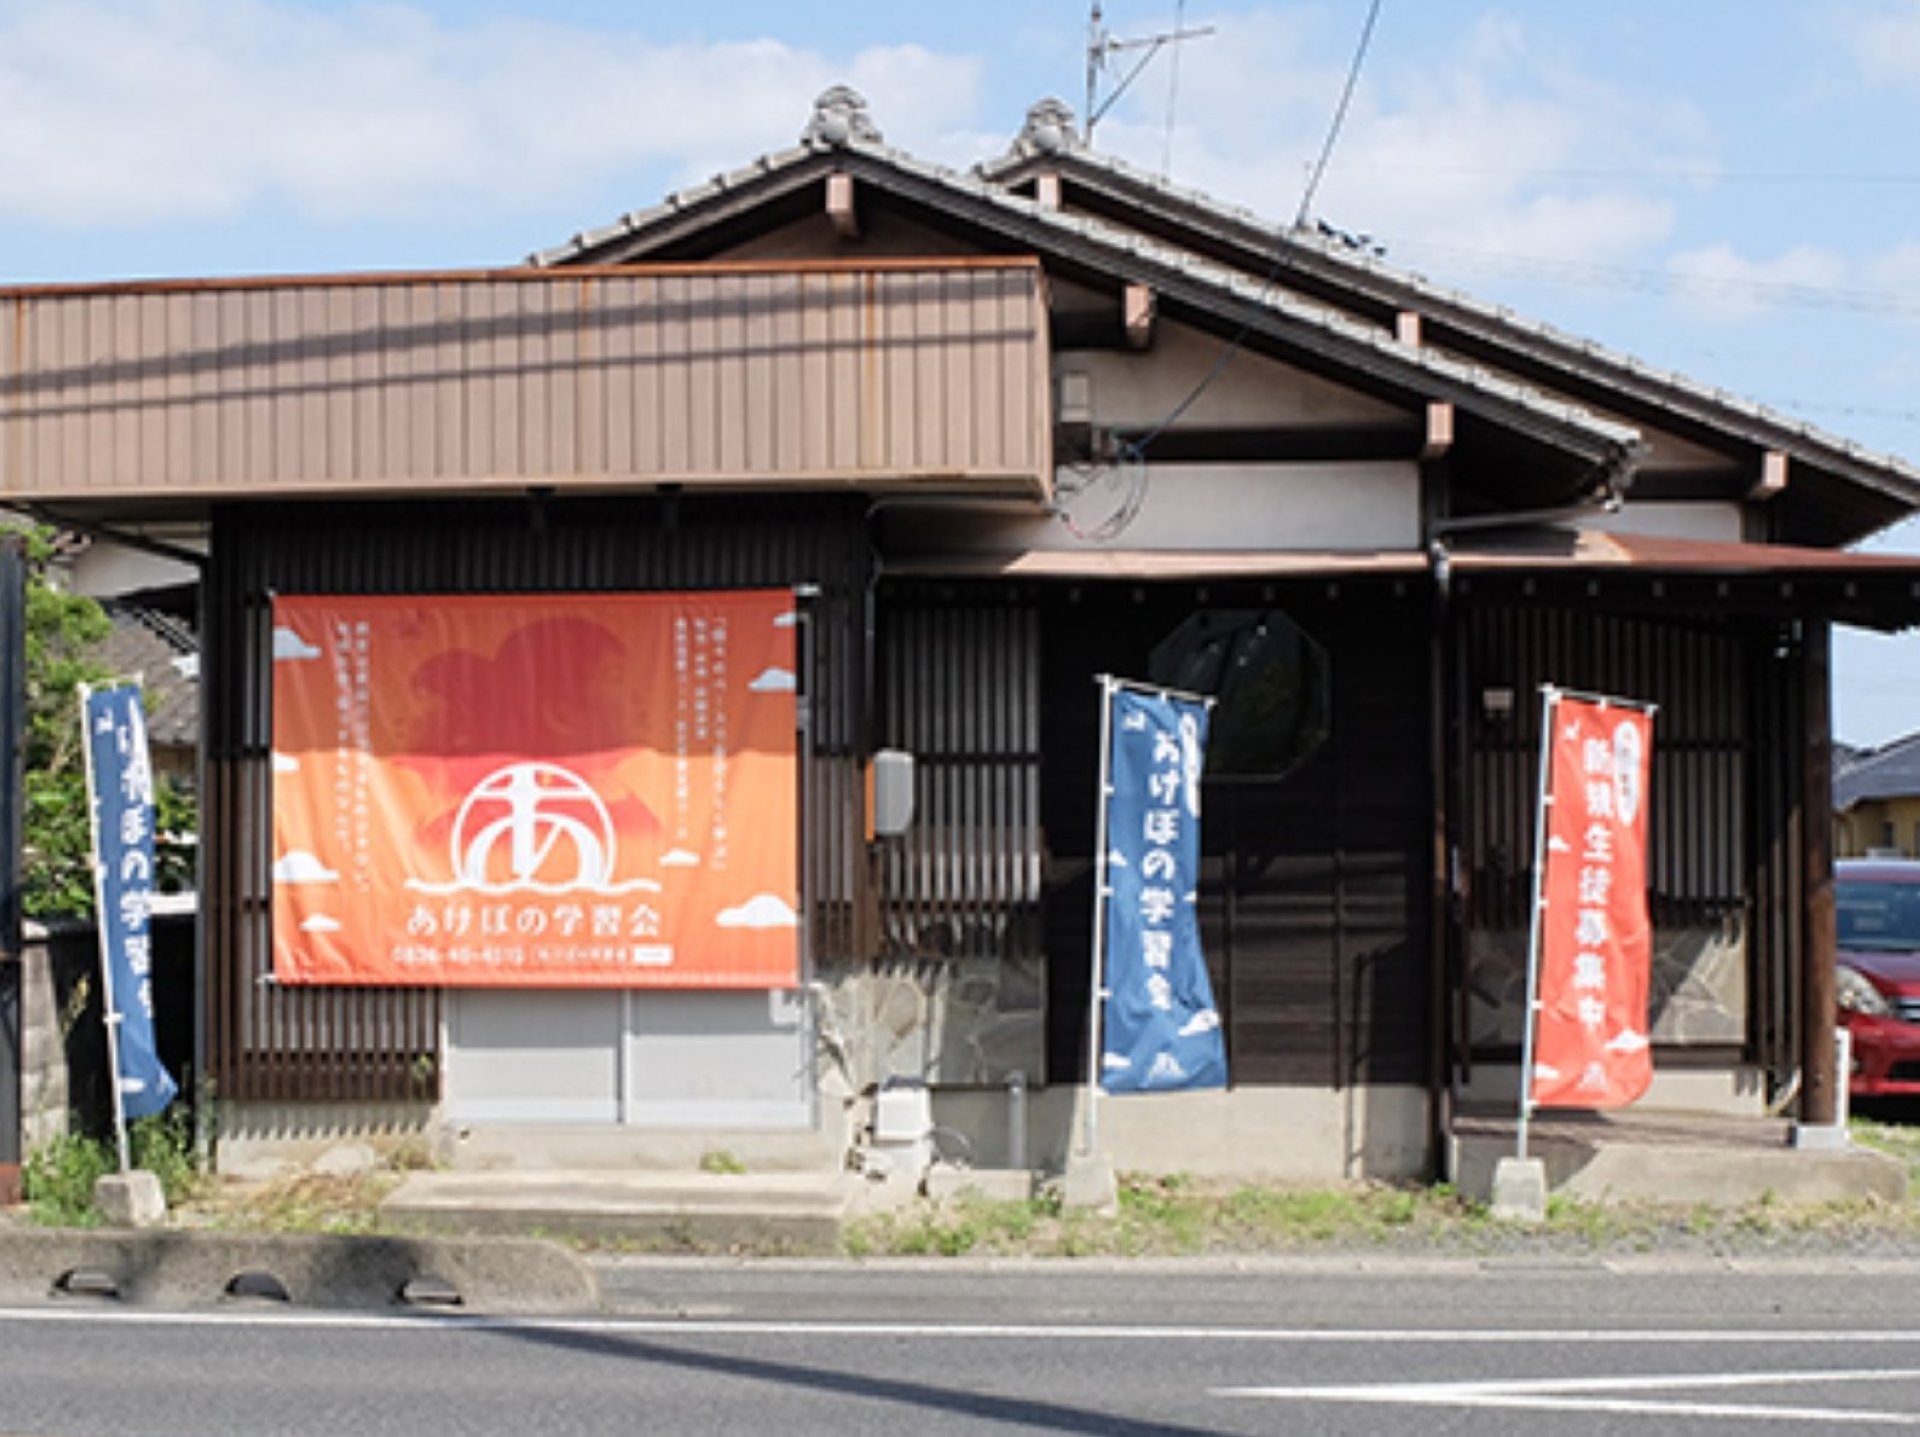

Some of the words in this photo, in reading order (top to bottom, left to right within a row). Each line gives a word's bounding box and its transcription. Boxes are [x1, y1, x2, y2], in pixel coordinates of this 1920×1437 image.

[407, 903, 661, 936] あけぼの学習会
[1139, 729, 1181, 1010] あけぼの学習会
